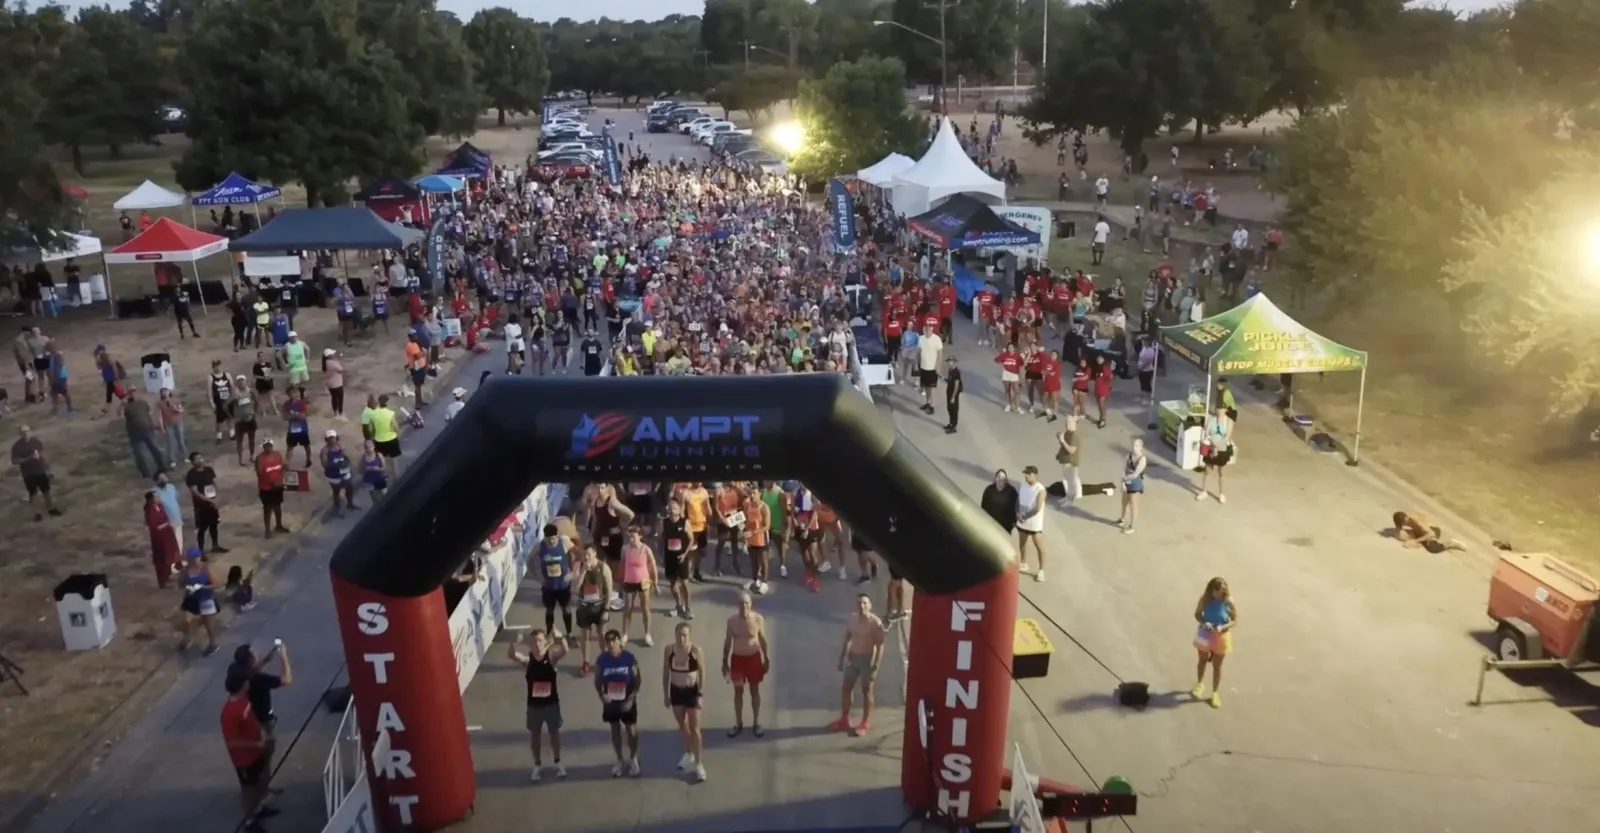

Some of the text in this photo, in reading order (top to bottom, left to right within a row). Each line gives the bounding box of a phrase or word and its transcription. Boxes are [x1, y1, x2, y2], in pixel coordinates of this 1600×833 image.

[837, 194, 849, 240] REFUEL
[999, 211, 1043, 222] ERGENCY
[1243, 332, 1307, 342] PICKLE
[1248, 342, 1313, 352] JUICE
[1225, 361, 1254, 370] STOP
[1257, 359, 1303, 369] MUSCLE
[632, 415, 760, 442] AMPT
[620, 445, 761, 458] RUNNING
[357, 602, 419, 825] START
[937, 600, 986, 818] FINISH
